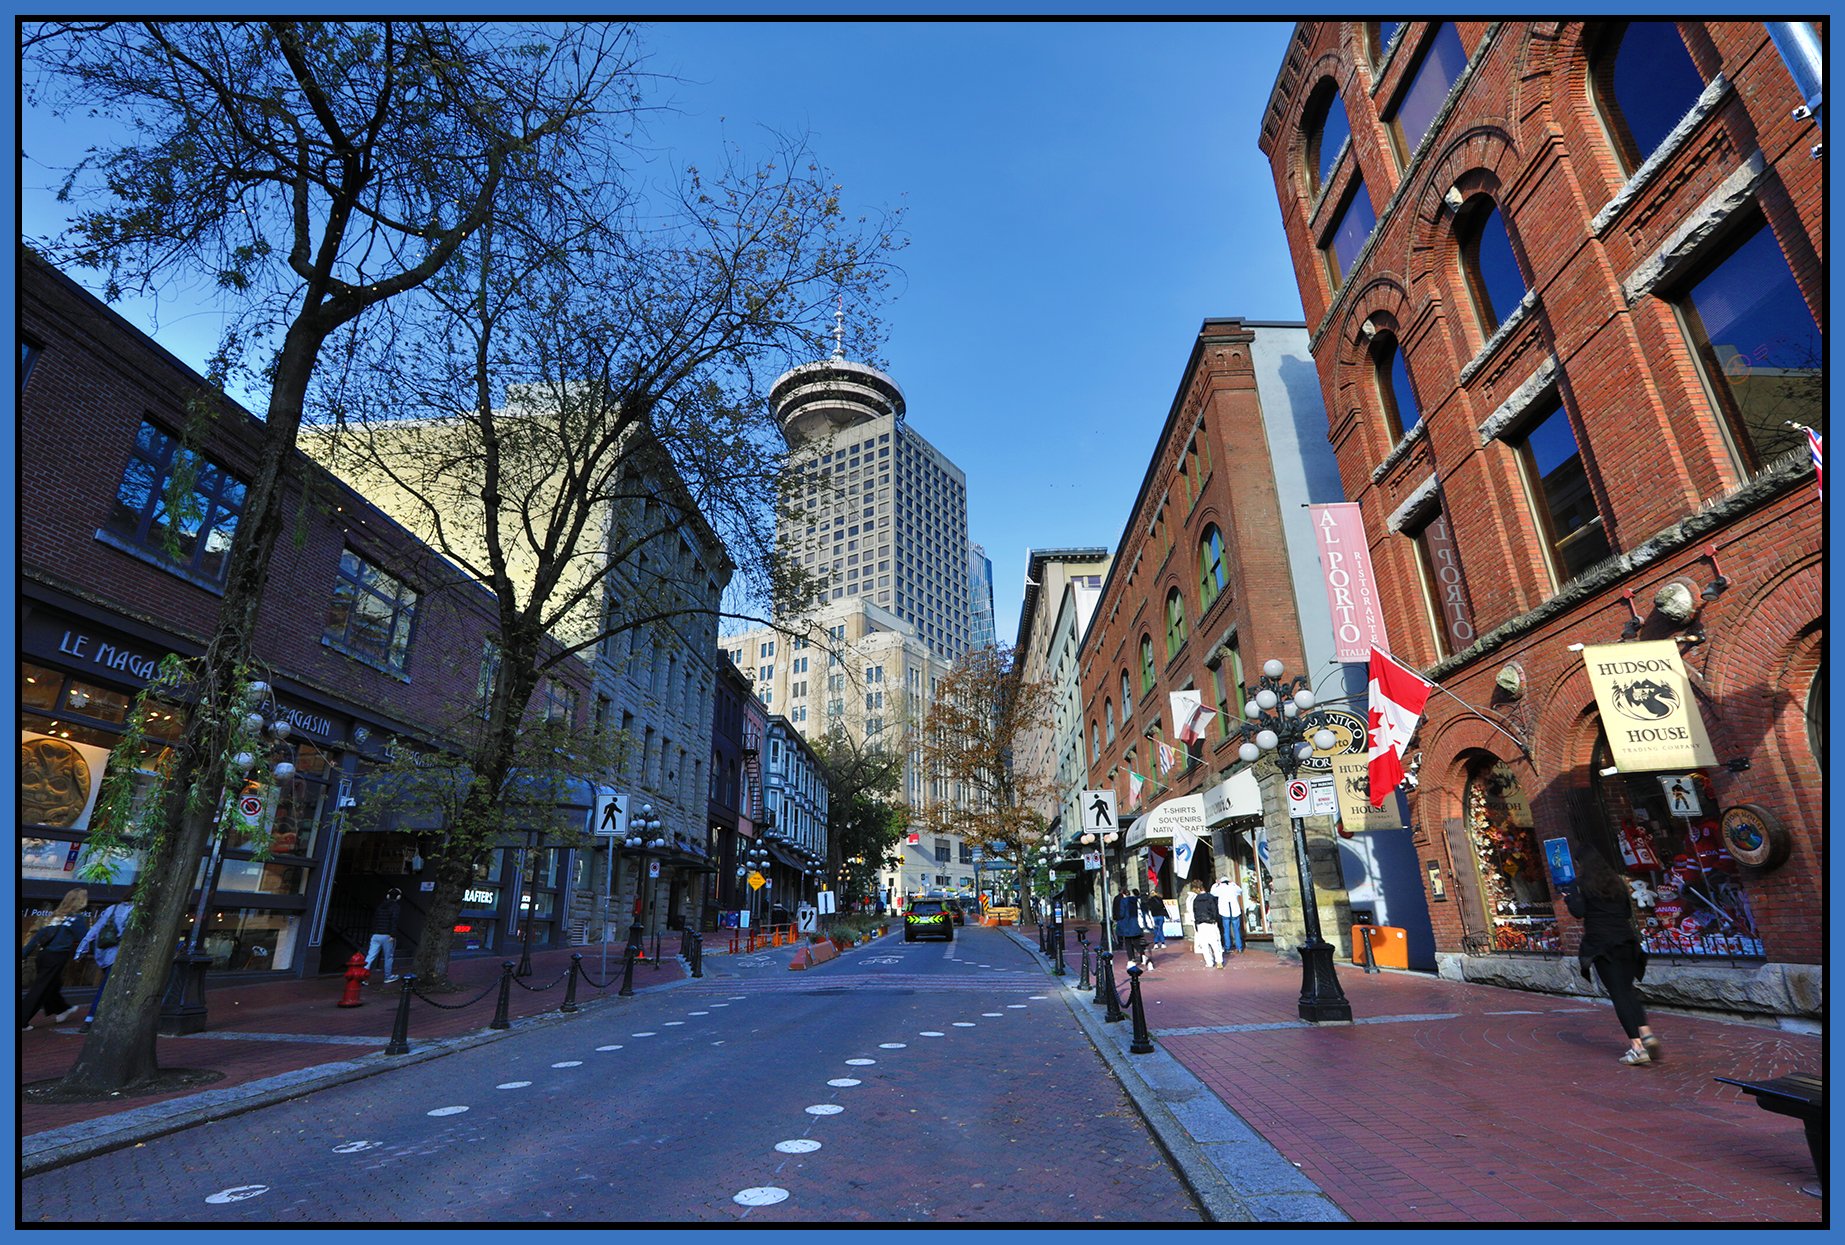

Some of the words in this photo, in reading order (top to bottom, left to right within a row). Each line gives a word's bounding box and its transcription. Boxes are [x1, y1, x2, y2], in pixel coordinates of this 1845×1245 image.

[1320, 509, 1340, 544] AL
[1328, 552, 1360, 643] PORTO
[1353, 552, 1379, 644] RISTORANTE
[58, 631, 89, 658] LE
[1341, 648, 1376, 657] ITALIA
[1597, 658, 1673, 675] HUDSON
[275, 704, 331, 736] AGASIN
[1626, 727, 1689, 743] HOUSE
[1662, 743, 1701, 751] COMPANY
[1339, 760, 1368, 773] HUDS
[1351, 804, 1387, 814] HOUSE
[462, 889, 494, 904] RAFTERS
